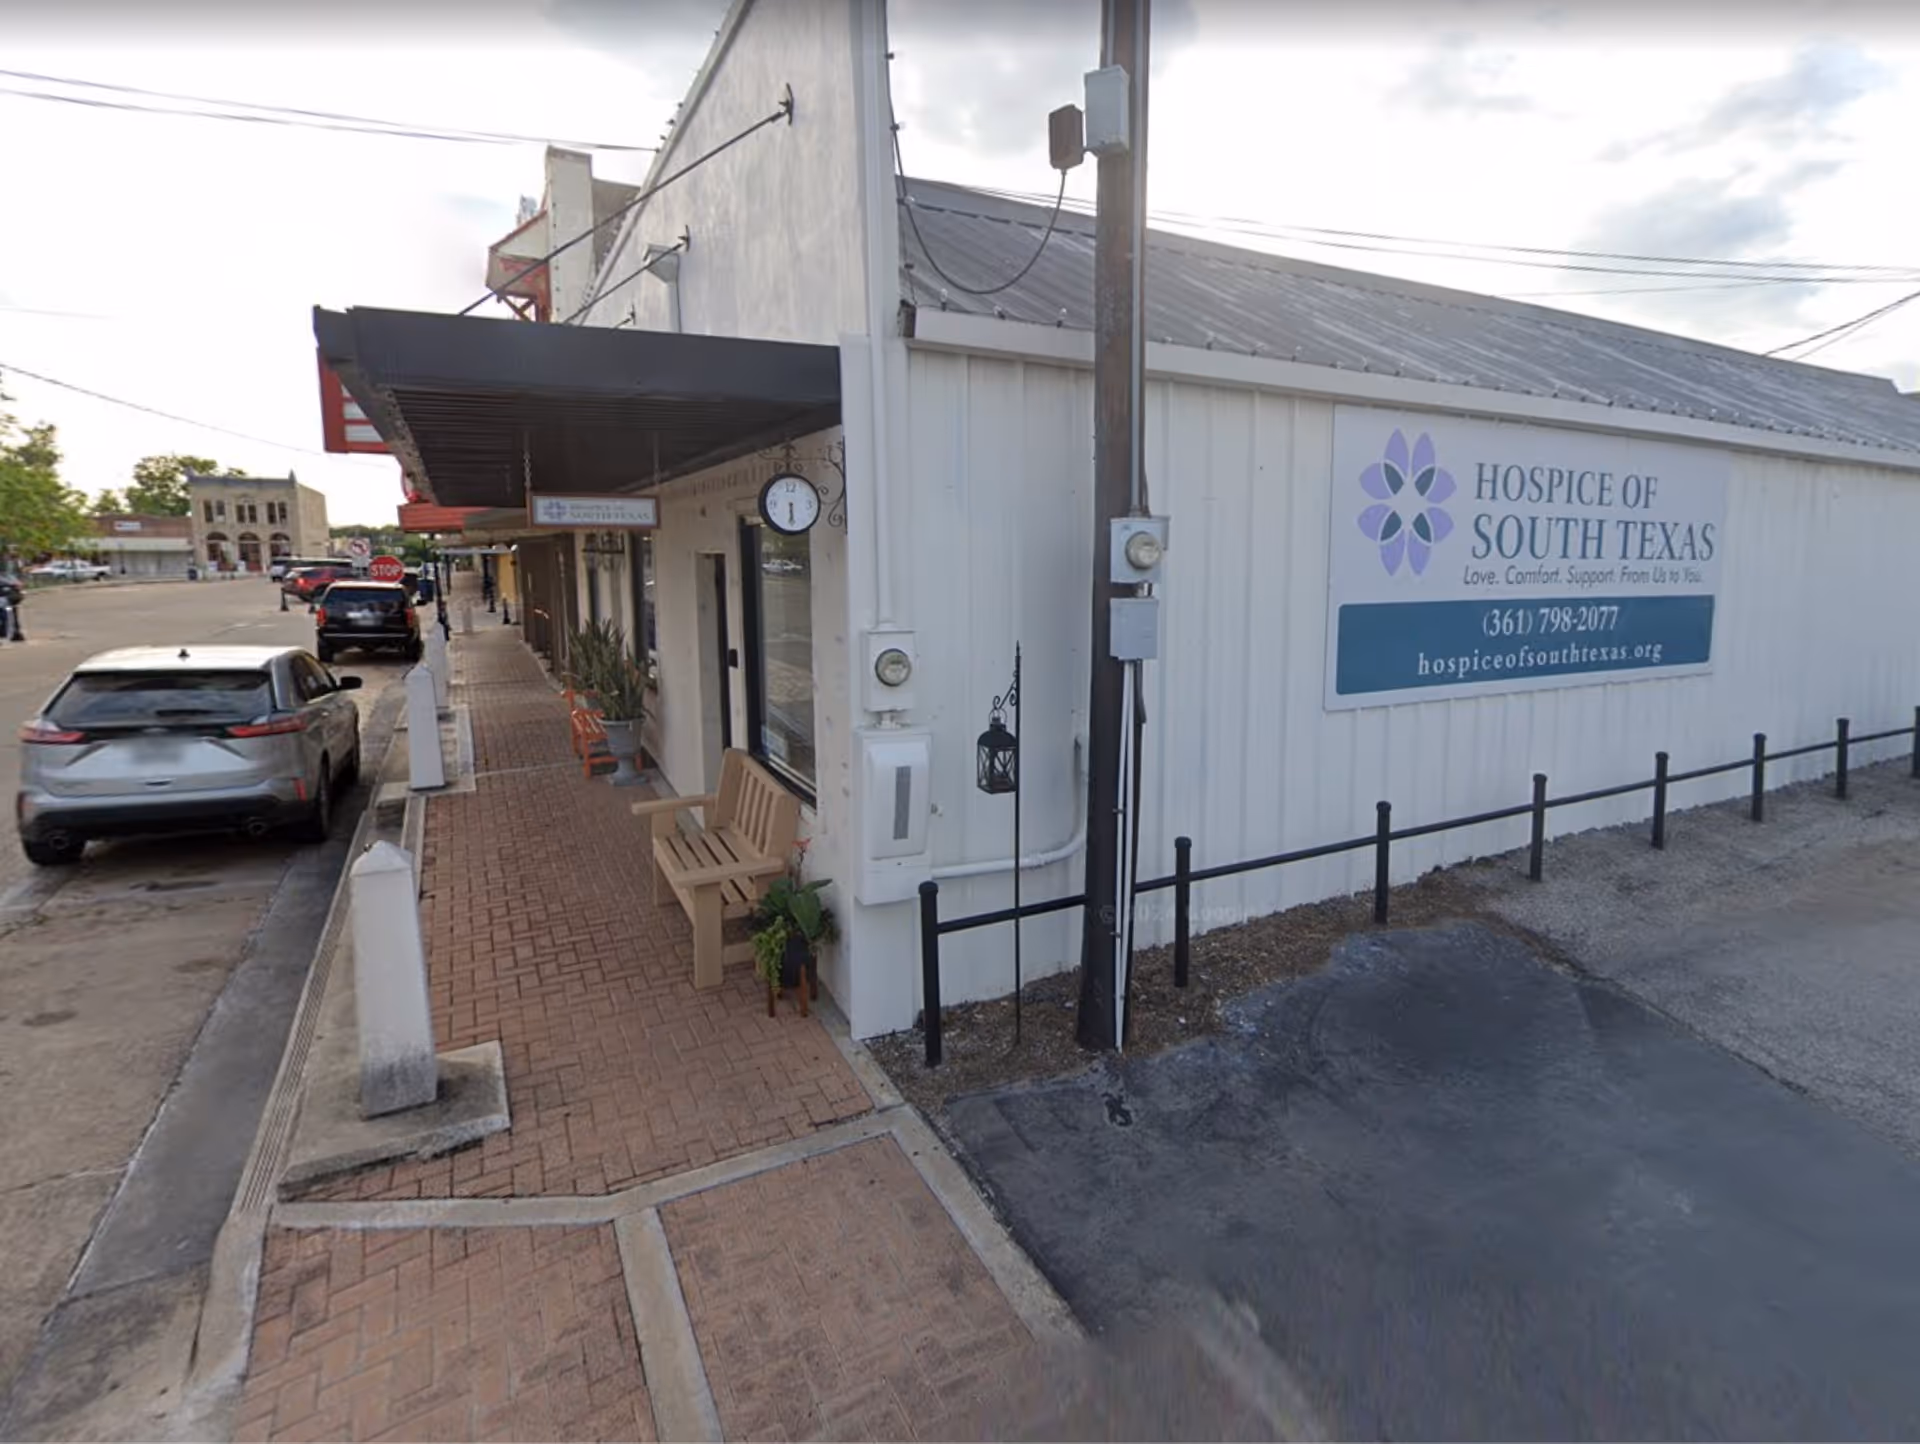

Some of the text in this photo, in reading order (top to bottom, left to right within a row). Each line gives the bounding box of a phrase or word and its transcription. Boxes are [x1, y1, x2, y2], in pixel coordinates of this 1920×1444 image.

[785, 482, 797, 493] 12
[1474, 462, 1658, 509] HOSPICE OF
[805, 499, 813, 511] 3
[1471, 513, 1716, 561] SOUTH TEXAS
[370, 564, 400, 577] STOP
[1463, 565, 1500, 586] Love.
[1505, 565, 1562, 586] Comfort.
[1567, 566, 1616, 589] Support.
[1621, 566, 1650, 585] From
[1652, 567, 1666, 584] Us
[1667, 569, 1680, 584] to
[1482, 605, 1620, 637] (361) 798-2077
[1417, 642, 1663, 677] hospiceofsouthtexas.org
